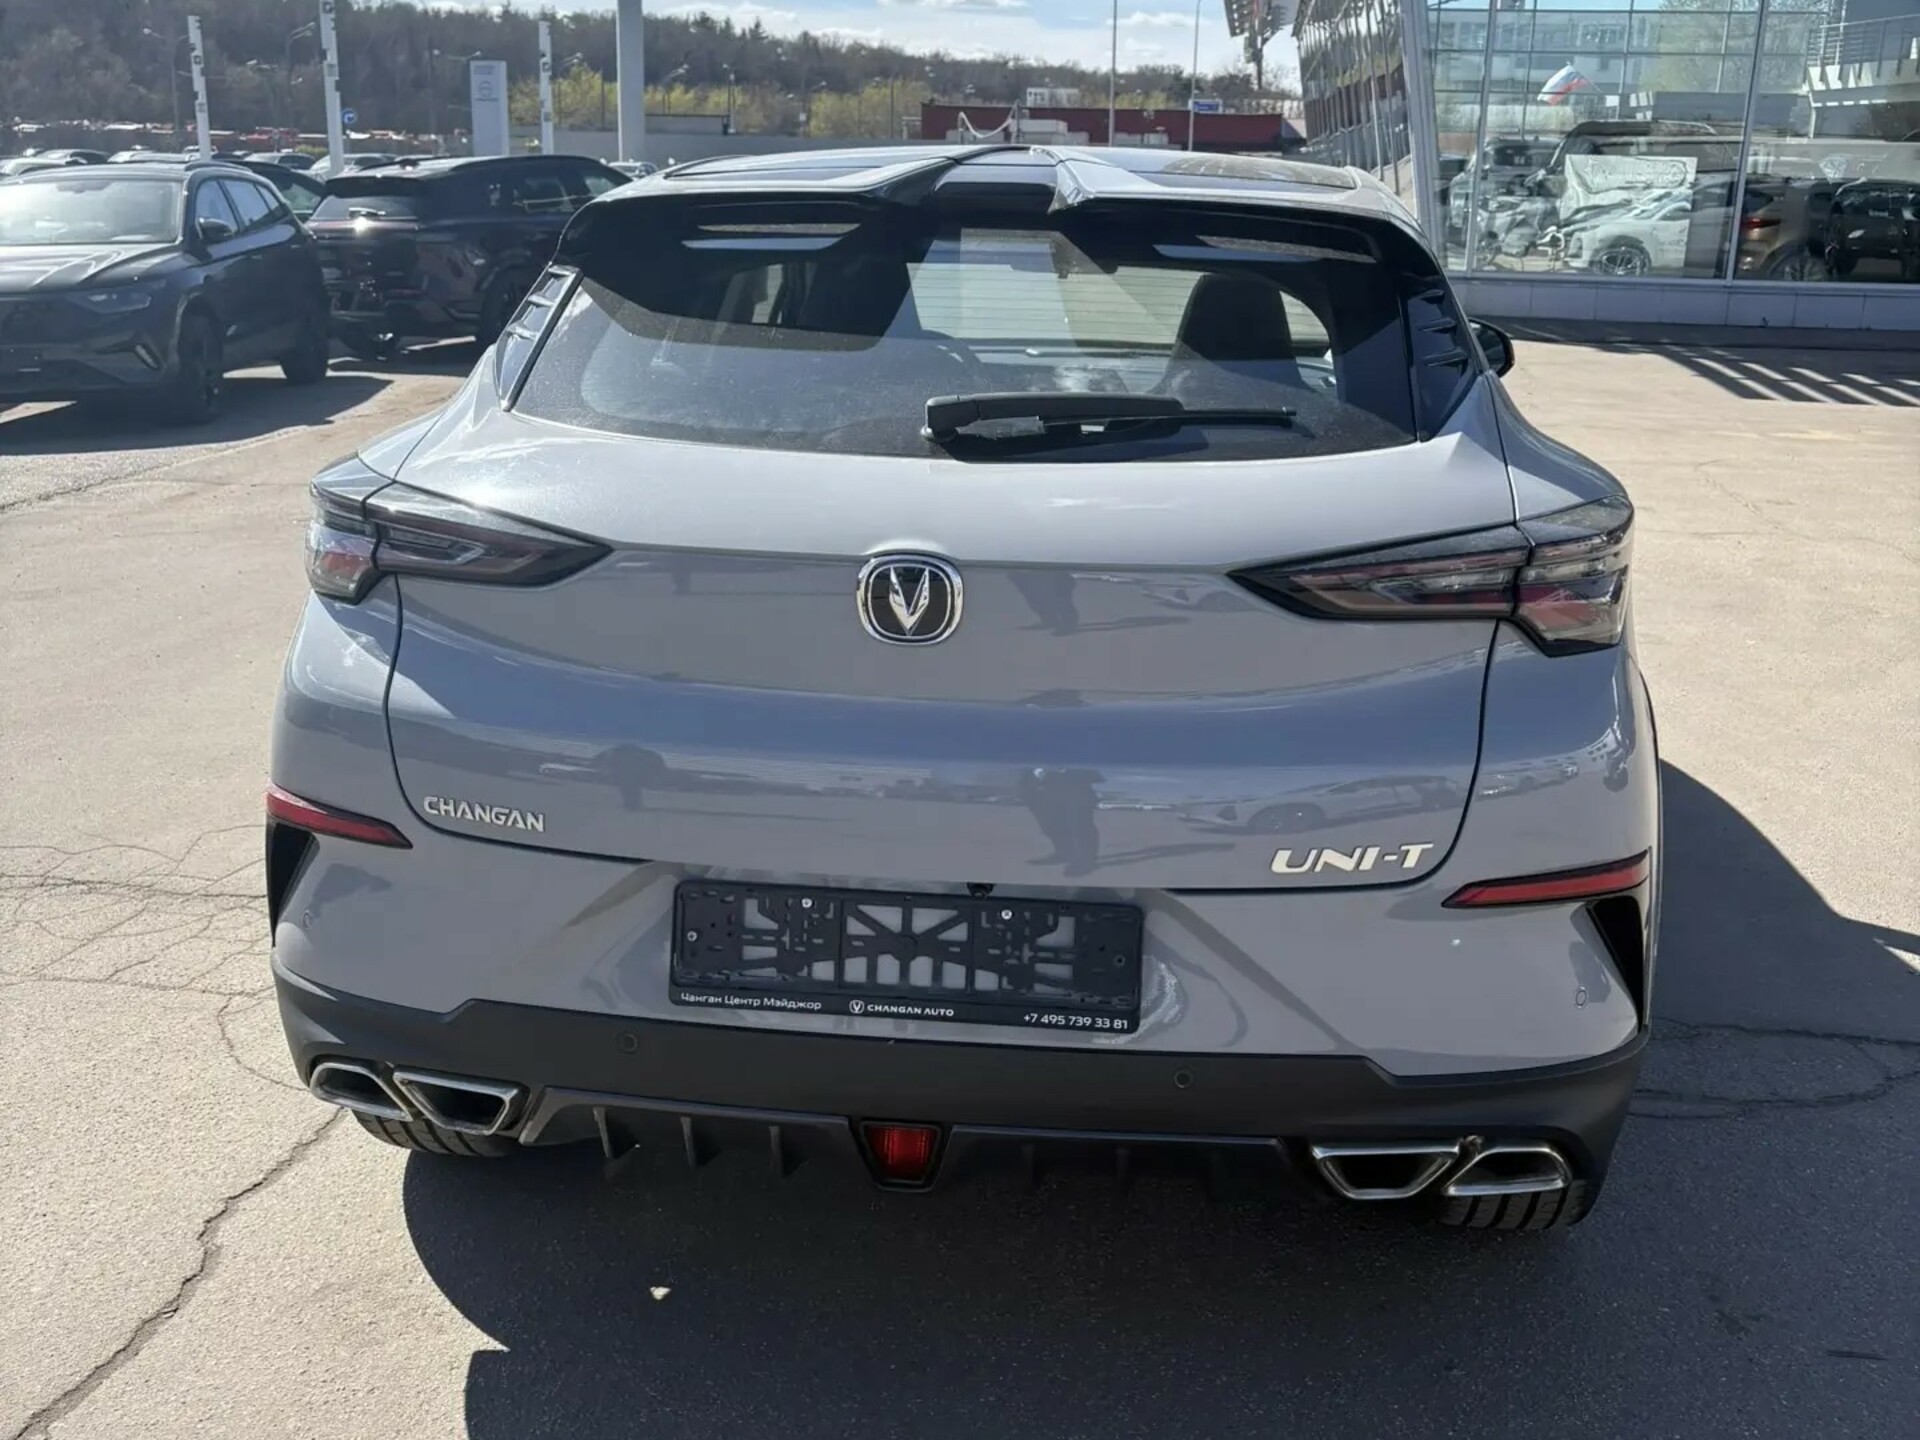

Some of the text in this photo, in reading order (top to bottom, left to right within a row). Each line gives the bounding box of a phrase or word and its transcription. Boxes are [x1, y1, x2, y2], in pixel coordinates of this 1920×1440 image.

[423, 795, 545, 832] CHANGAN
[1271, 843, 1434, 873] UNI-T
[680, 992, 822, 1010] Чанган Центр Мэйджор
[867, 1004, 955, 1017] CHANGAN AUTO
[1023, 1013, 1128, 1030] +7 495 739 33 81
